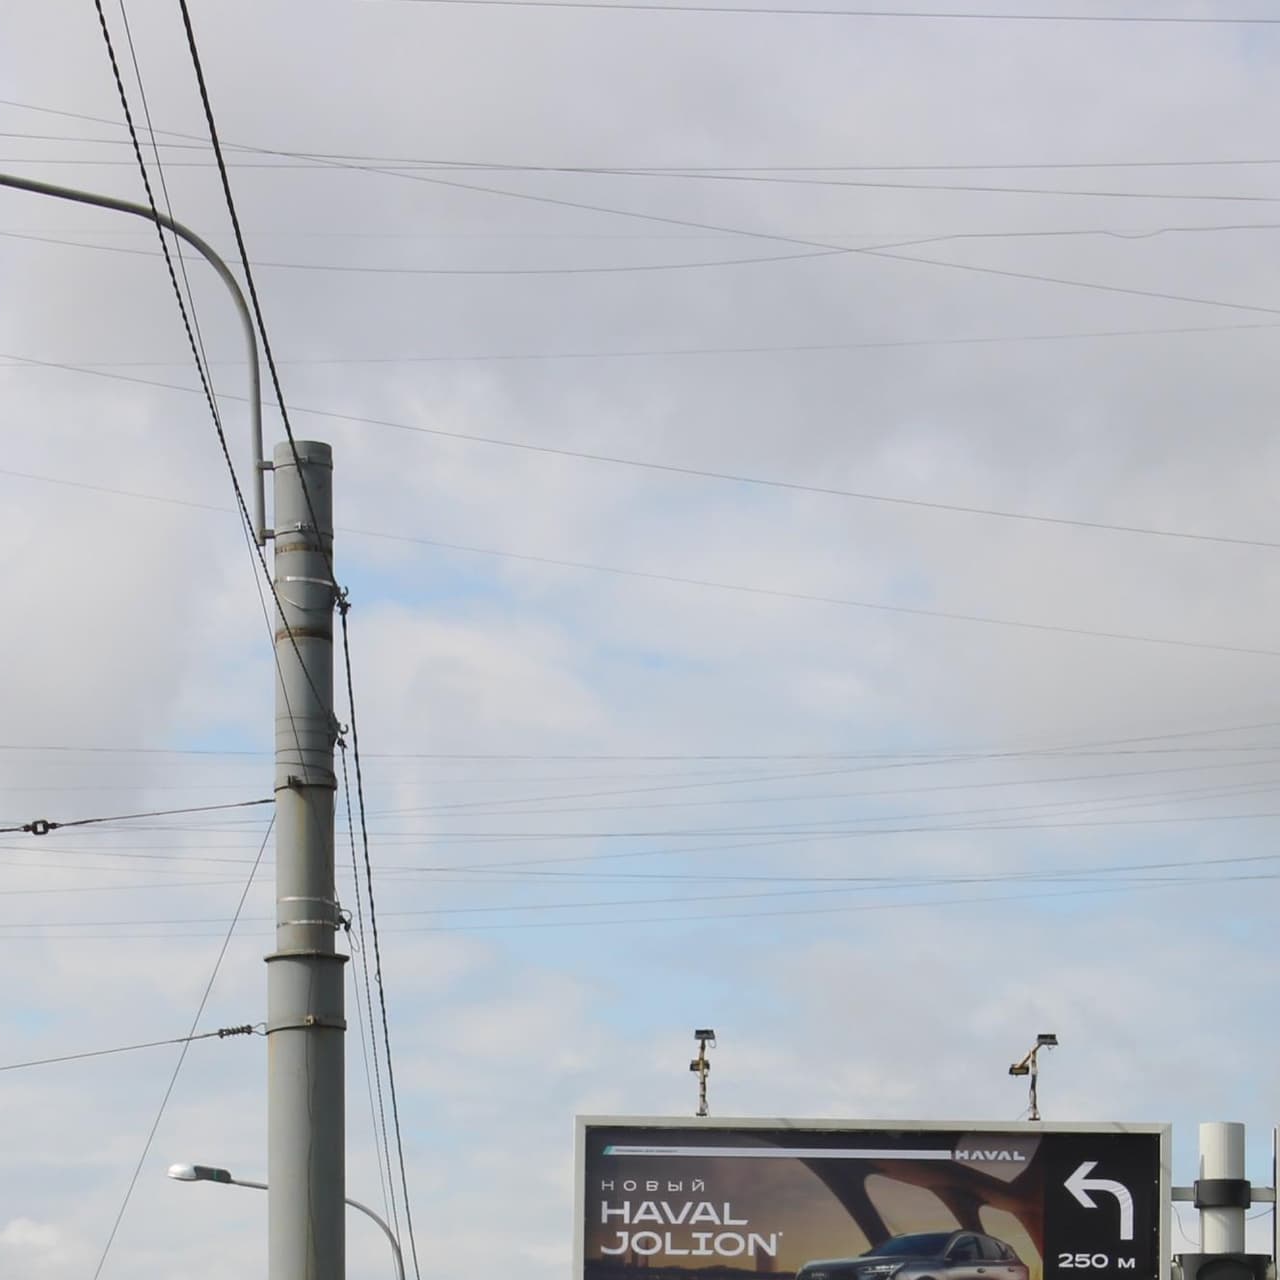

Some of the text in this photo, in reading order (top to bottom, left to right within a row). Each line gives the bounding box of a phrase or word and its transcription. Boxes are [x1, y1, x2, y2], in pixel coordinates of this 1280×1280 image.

[955, 1150, 1025, 1160] HAVAL
[601, 1179, 705, 1192] НОВЫЙ
[601, 1201, 748, 1225] HAVAL
[1058, 1254, 1109, 1269] 250
